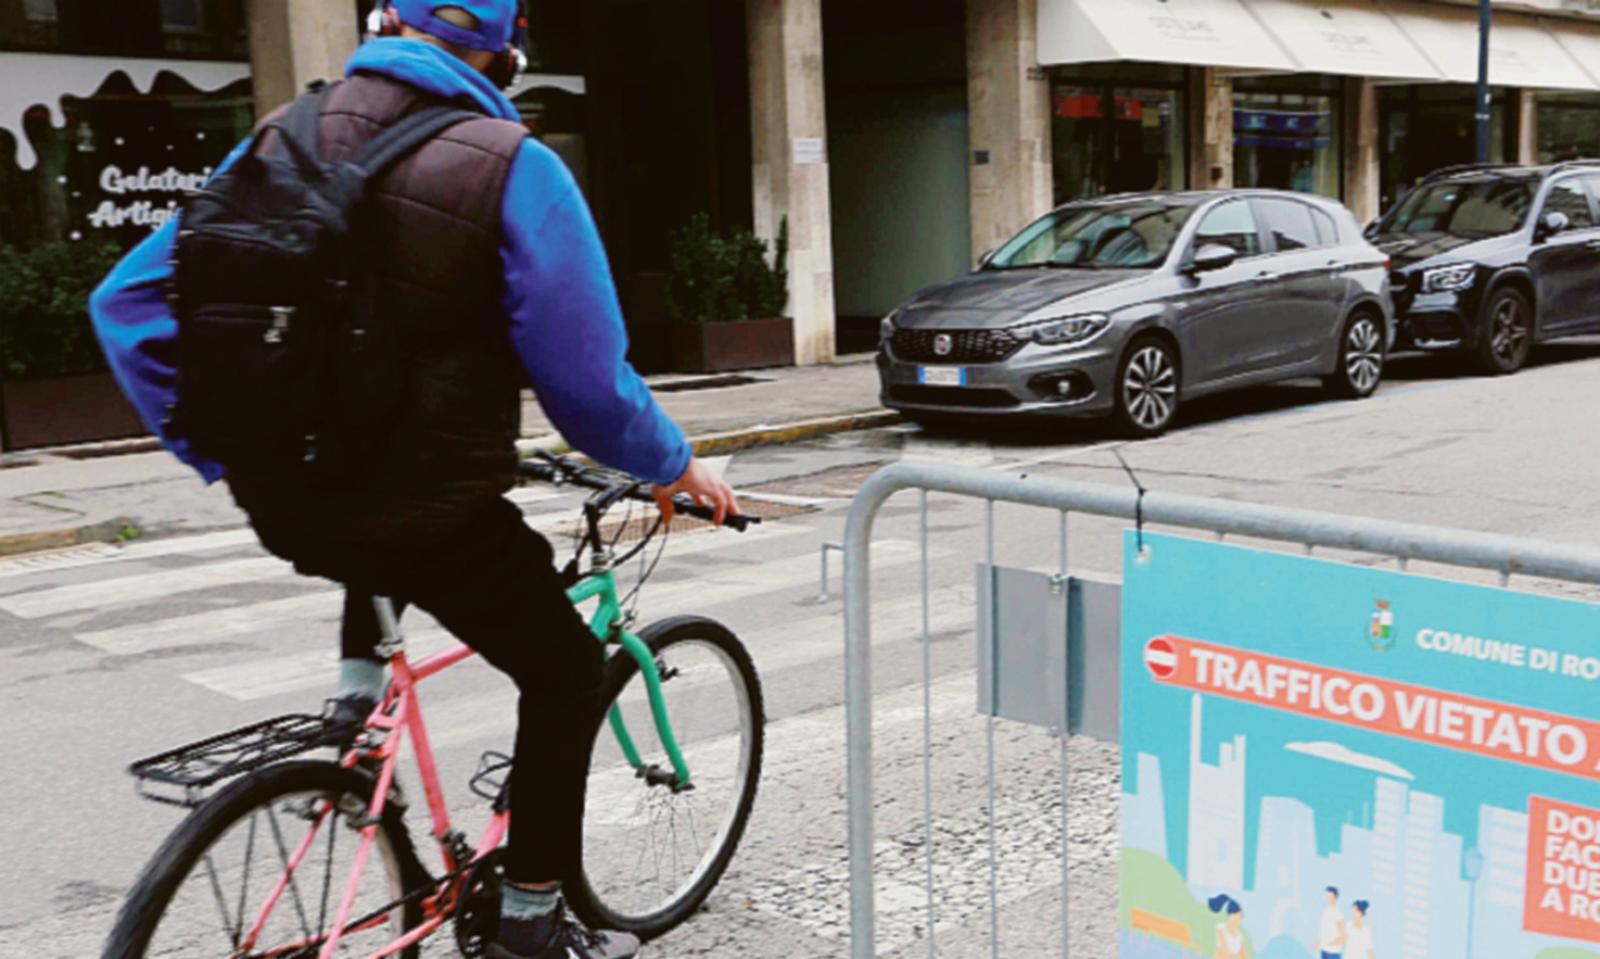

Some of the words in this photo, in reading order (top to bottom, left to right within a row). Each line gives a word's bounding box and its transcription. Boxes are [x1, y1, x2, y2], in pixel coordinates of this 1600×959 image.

[1416, 627, 1526, 667] COMUNE
[1529, 647, 1558, 673] DI
[1190, 648, 1385, 721] TRAFFICO
[1393, 690, 1588, 765] VIETATO
[1540, 887, 1564, 913] A
